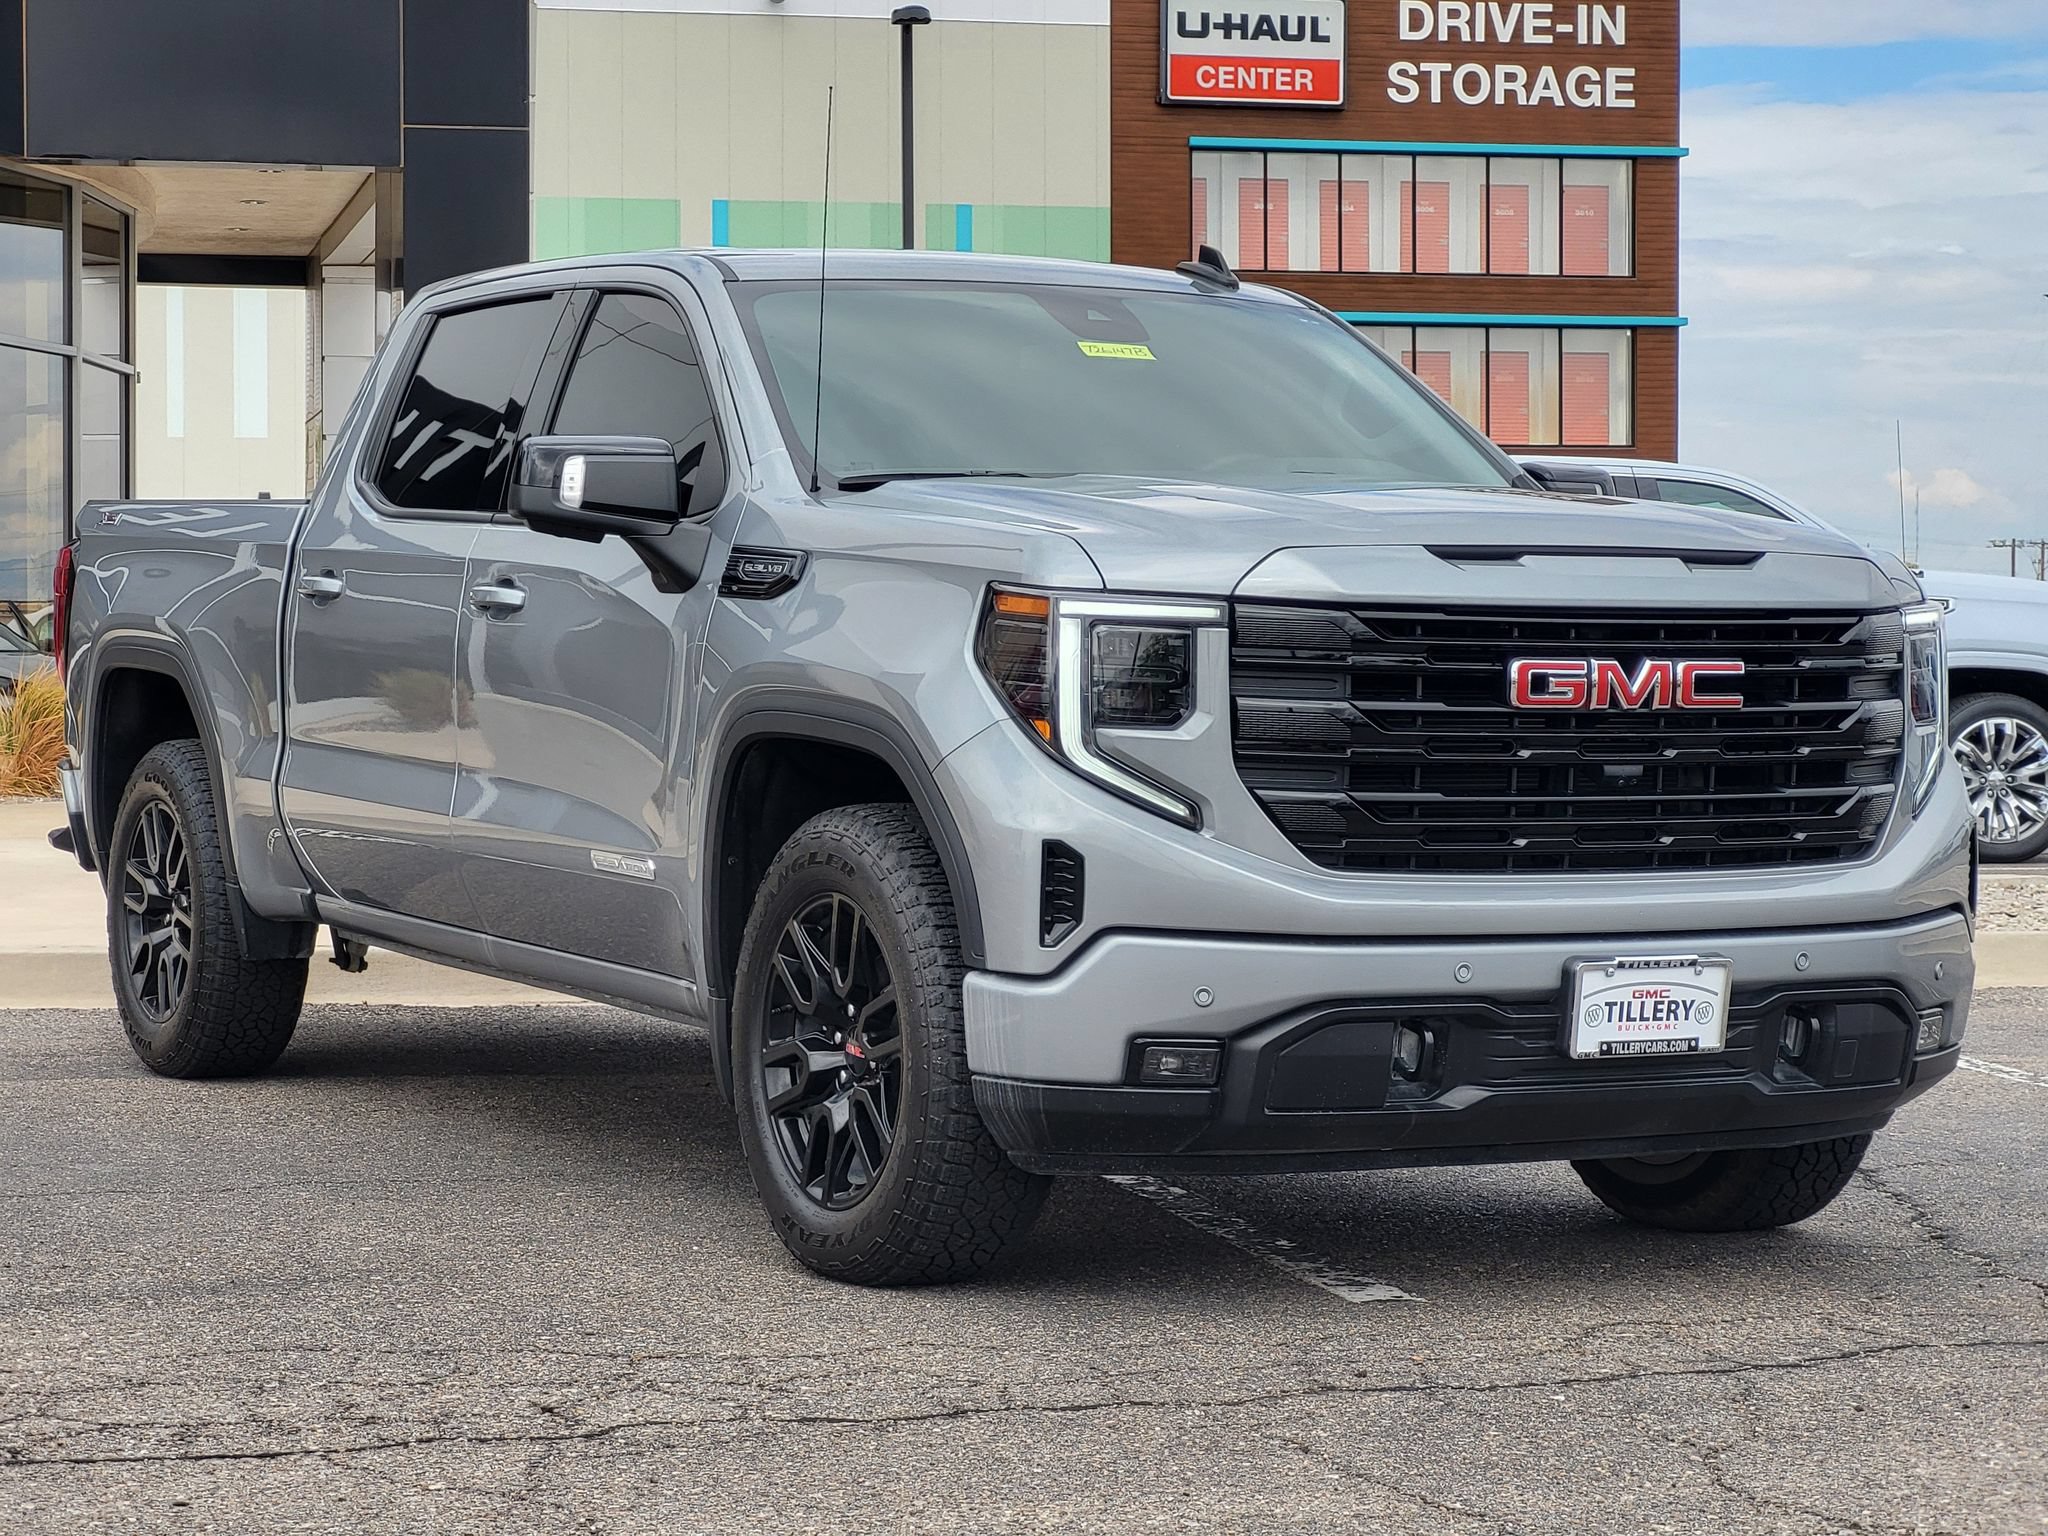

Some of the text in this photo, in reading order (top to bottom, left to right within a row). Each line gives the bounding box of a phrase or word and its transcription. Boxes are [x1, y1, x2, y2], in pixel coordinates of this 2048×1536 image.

[1177, 11, 1330, 43] U-HAUL
[1399, 0, 1626, 46] DRIVE-IN
[1196, 65, 1313, 91] CENTER
[1387, 61, 1636, 108] STORAGE
[1510, 658, 1745, 710] GMC
[1622, 959, 1692, 969] TILLERY
[1632, 989, 1671, 999] GMC
[1604, 999, 1697, 1024] TILLERY
[1611, 1039, 1689, 1055] TILLERYCARS.COM
